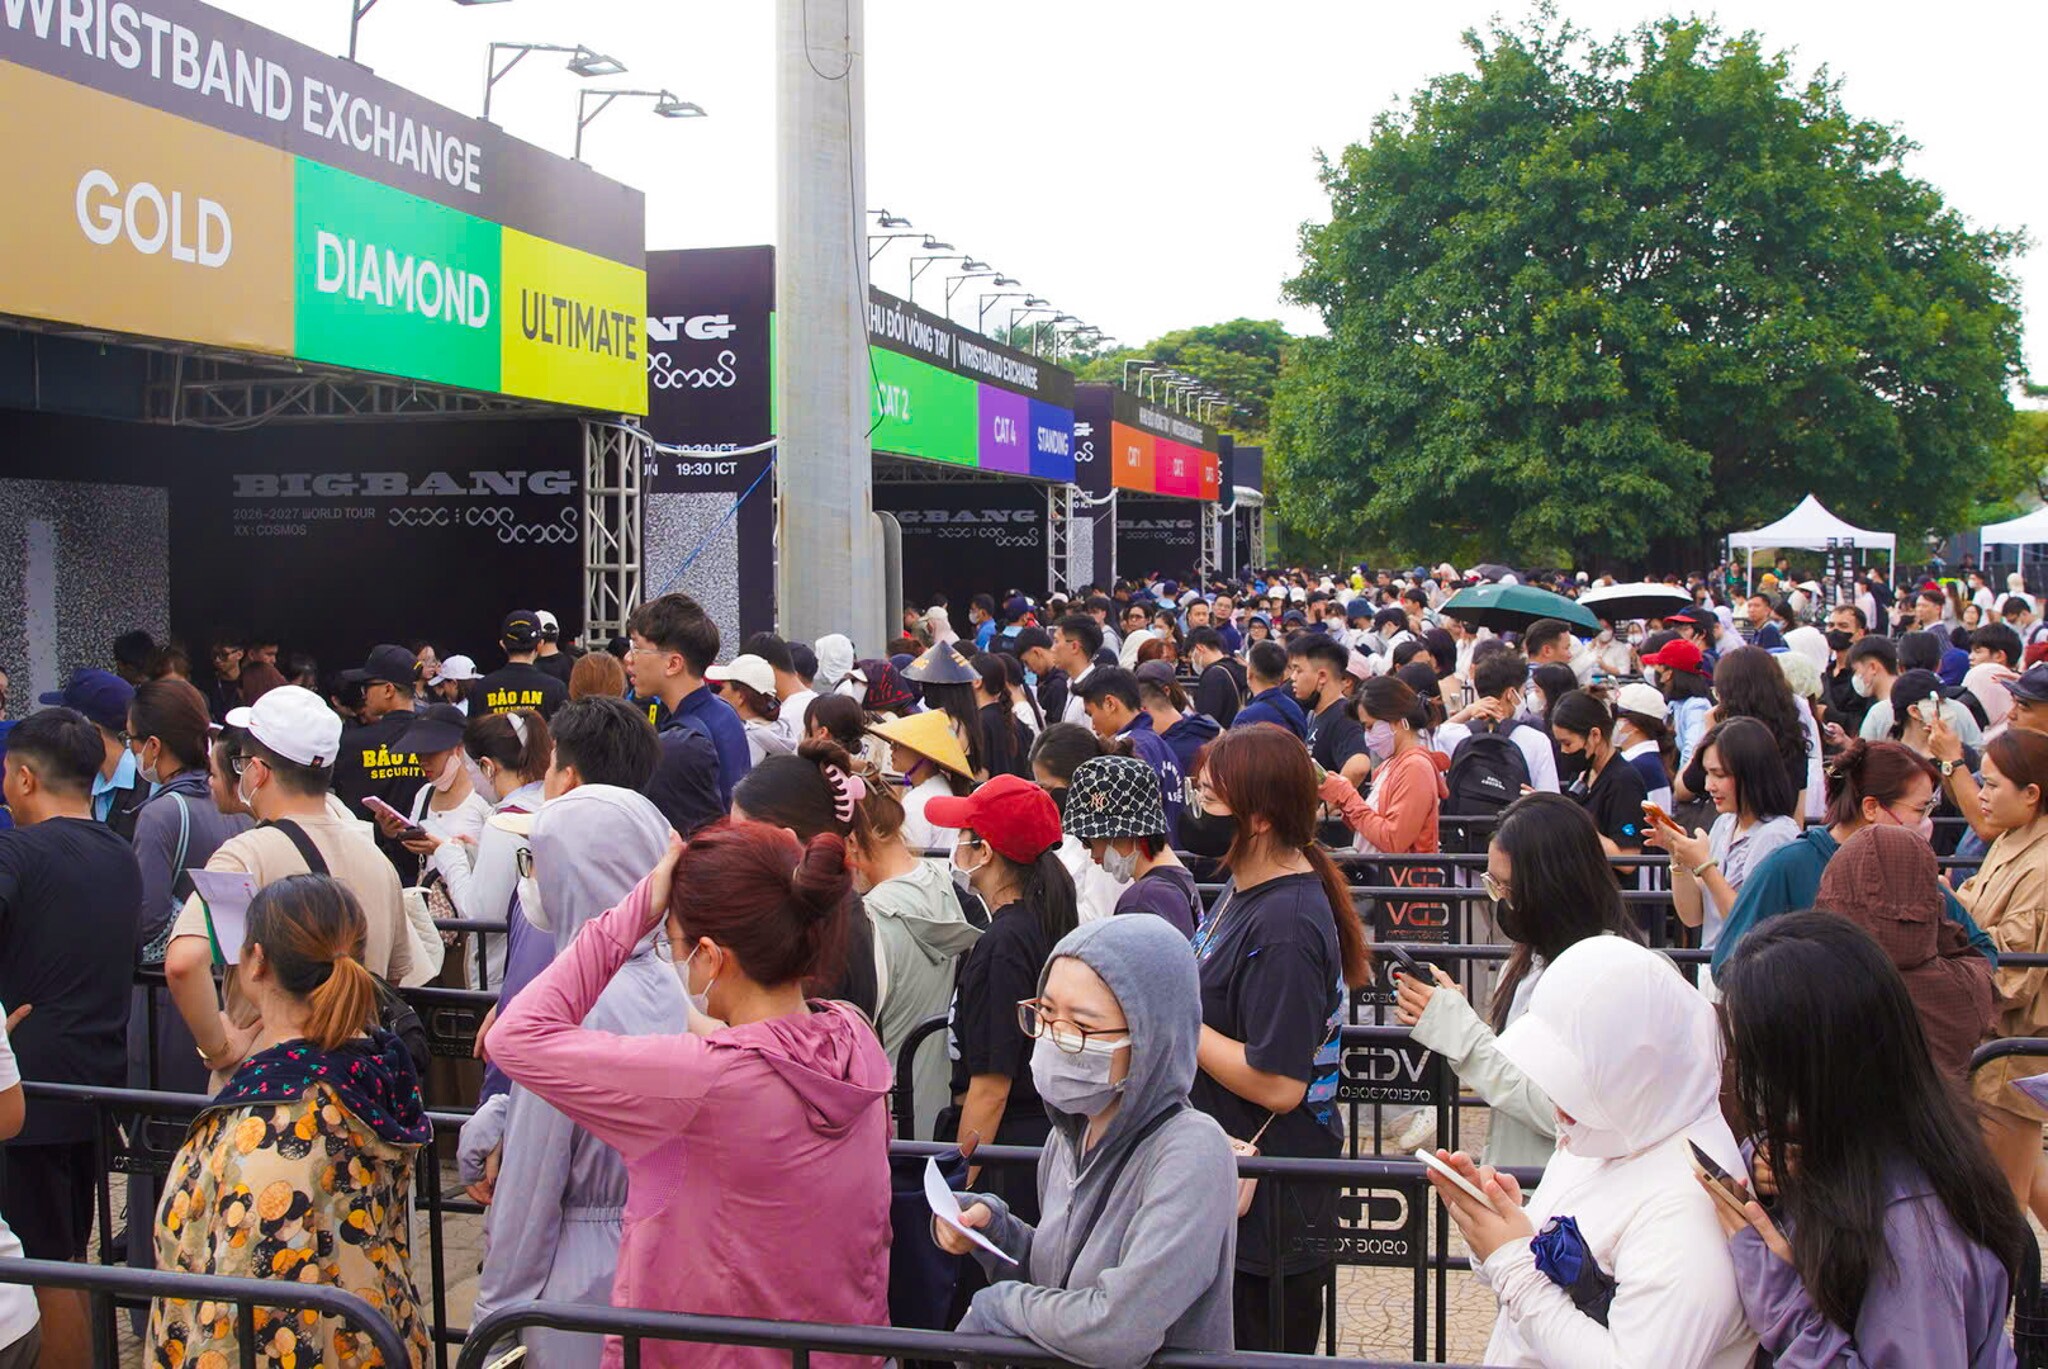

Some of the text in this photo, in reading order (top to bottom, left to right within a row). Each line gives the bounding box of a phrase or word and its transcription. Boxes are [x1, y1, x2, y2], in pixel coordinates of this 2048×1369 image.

[4, 0, 481, 194] WRISTBAND EXCHANGE
[76, 169, 233, 268] GOLD
[316, 230, 490, 329] DIAMOND
[521, 288, 637, 362] ULTIMATE
[870, 303, 885, 334] HU
[886, 303, 905, 342] ĐỔI
[906, 313, 933, 352] VÒNG
[933, 328, 951, 359] TAY
[958, 338, 1002, 379] WRISTBAND
[1003, 356, 1038, 390] EXCHANGE
[878, 383, 911, 419] CAT 2
[994, 416, 1017, 445] CAT 4
[1038, 426, 1069, 456] STANDING
[676, 463, 712, 476] 19:30
[715, 462, 738, 475] ICT
[233, 471, 578, 497] BIGBANG
[233, 507, 376, 520] 2026-2027 WORLD TOUR
[896, 509, 1038, 523] GBANG
[1117, 519, 1195, 529] BANG
[233, 525, 250, 536] XX
[256, 523, 307, 536] COSMOS
[487, 687, 543, 706] BẢO AN
[407, 753, 420, 763] A
